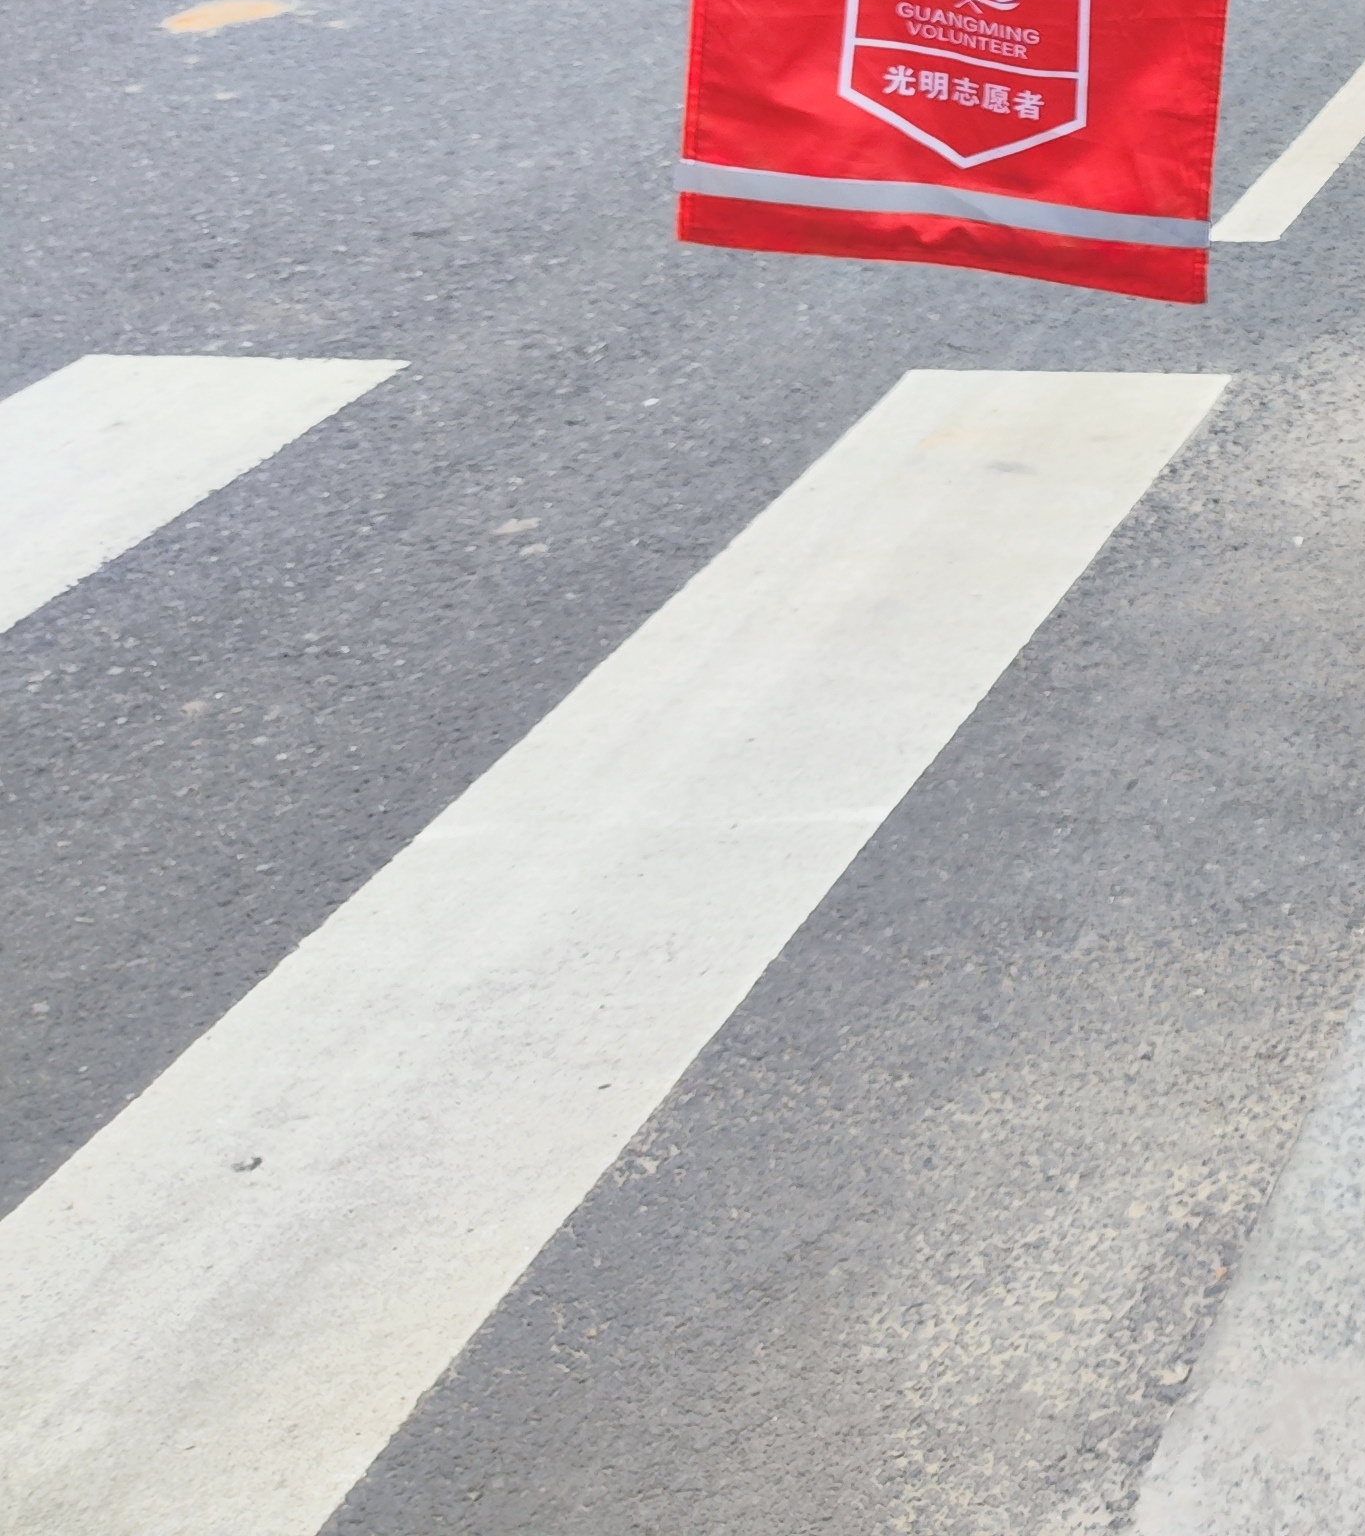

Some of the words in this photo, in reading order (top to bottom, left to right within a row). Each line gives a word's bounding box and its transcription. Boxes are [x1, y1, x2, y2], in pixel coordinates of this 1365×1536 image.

[896, 2, 1040, 45] GUANGMING
[906, 20, 1028, 59] VOLUNTEER
[882, 65, 1045, 121] 光明志愿者
